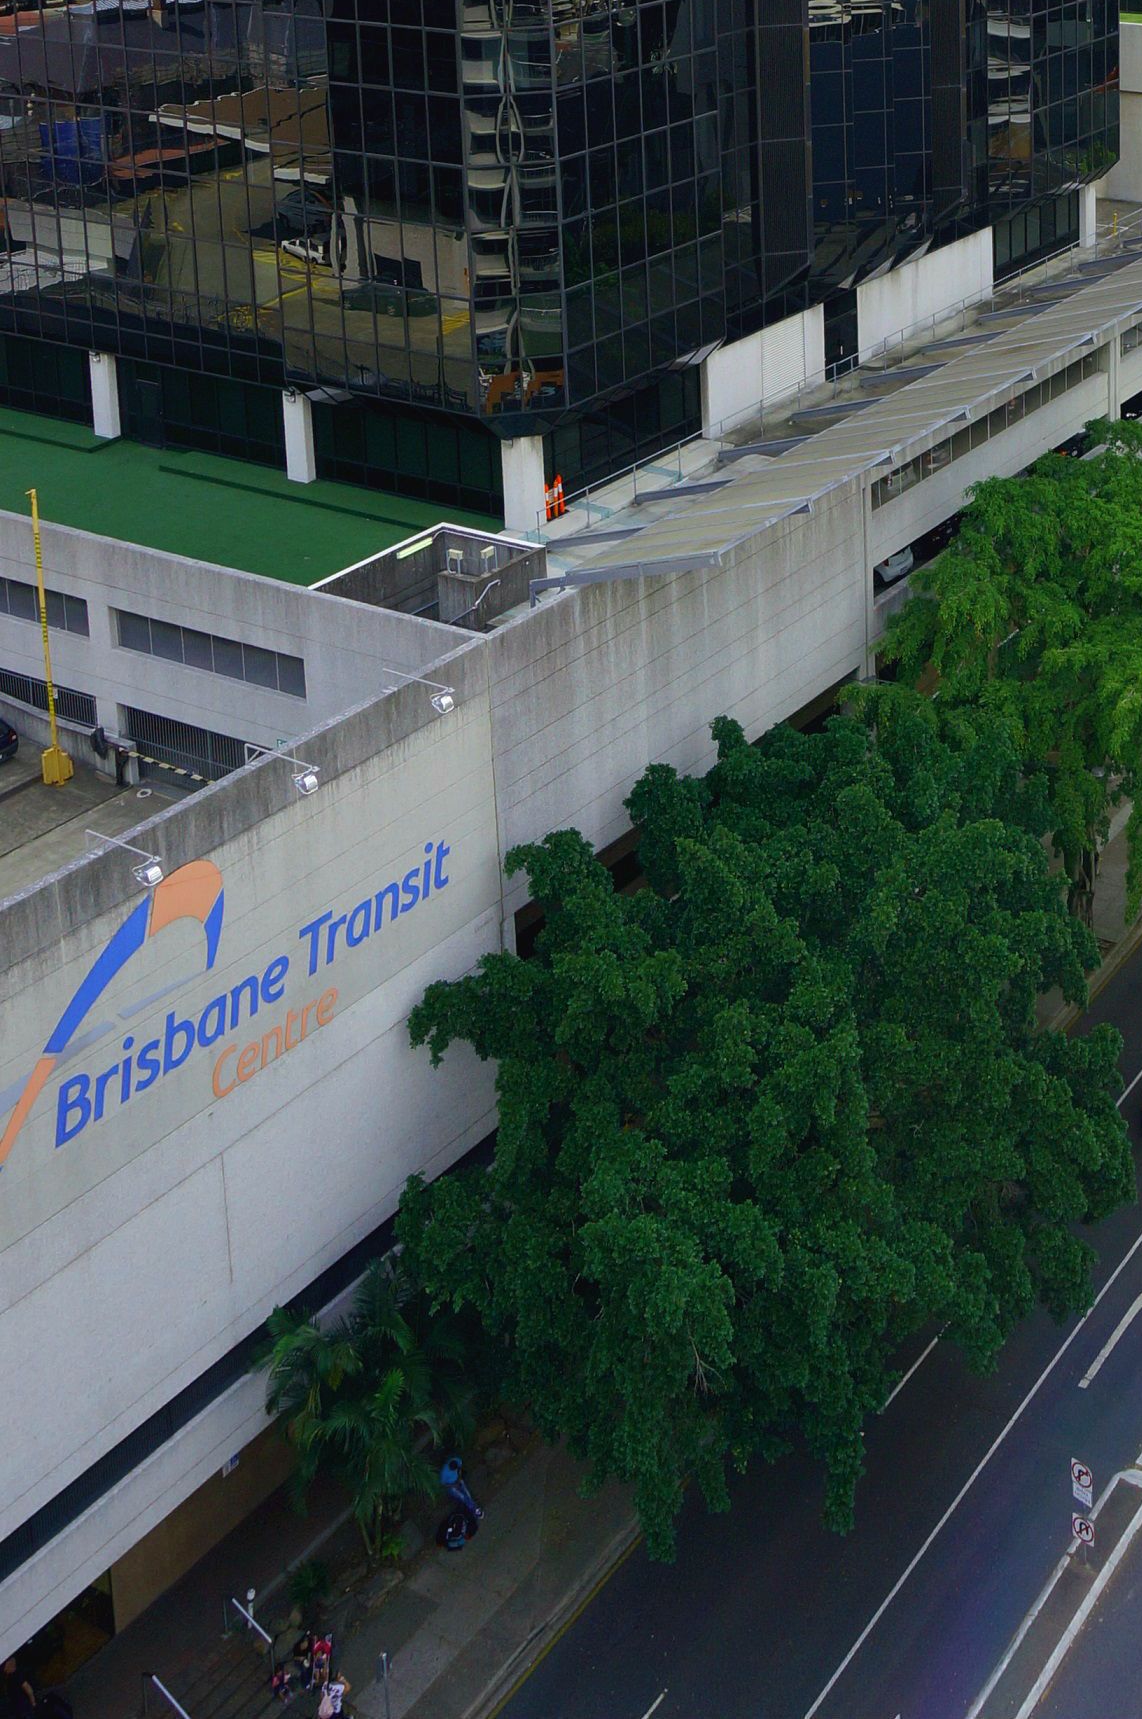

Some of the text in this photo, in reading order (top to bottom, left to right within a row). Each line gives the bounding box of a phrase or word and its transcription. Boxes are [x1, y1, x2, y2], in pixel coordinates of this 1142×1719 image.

[55, 839, 451, 1149] Brisbane Transit
[212, 987, 338, 1099] Centre
